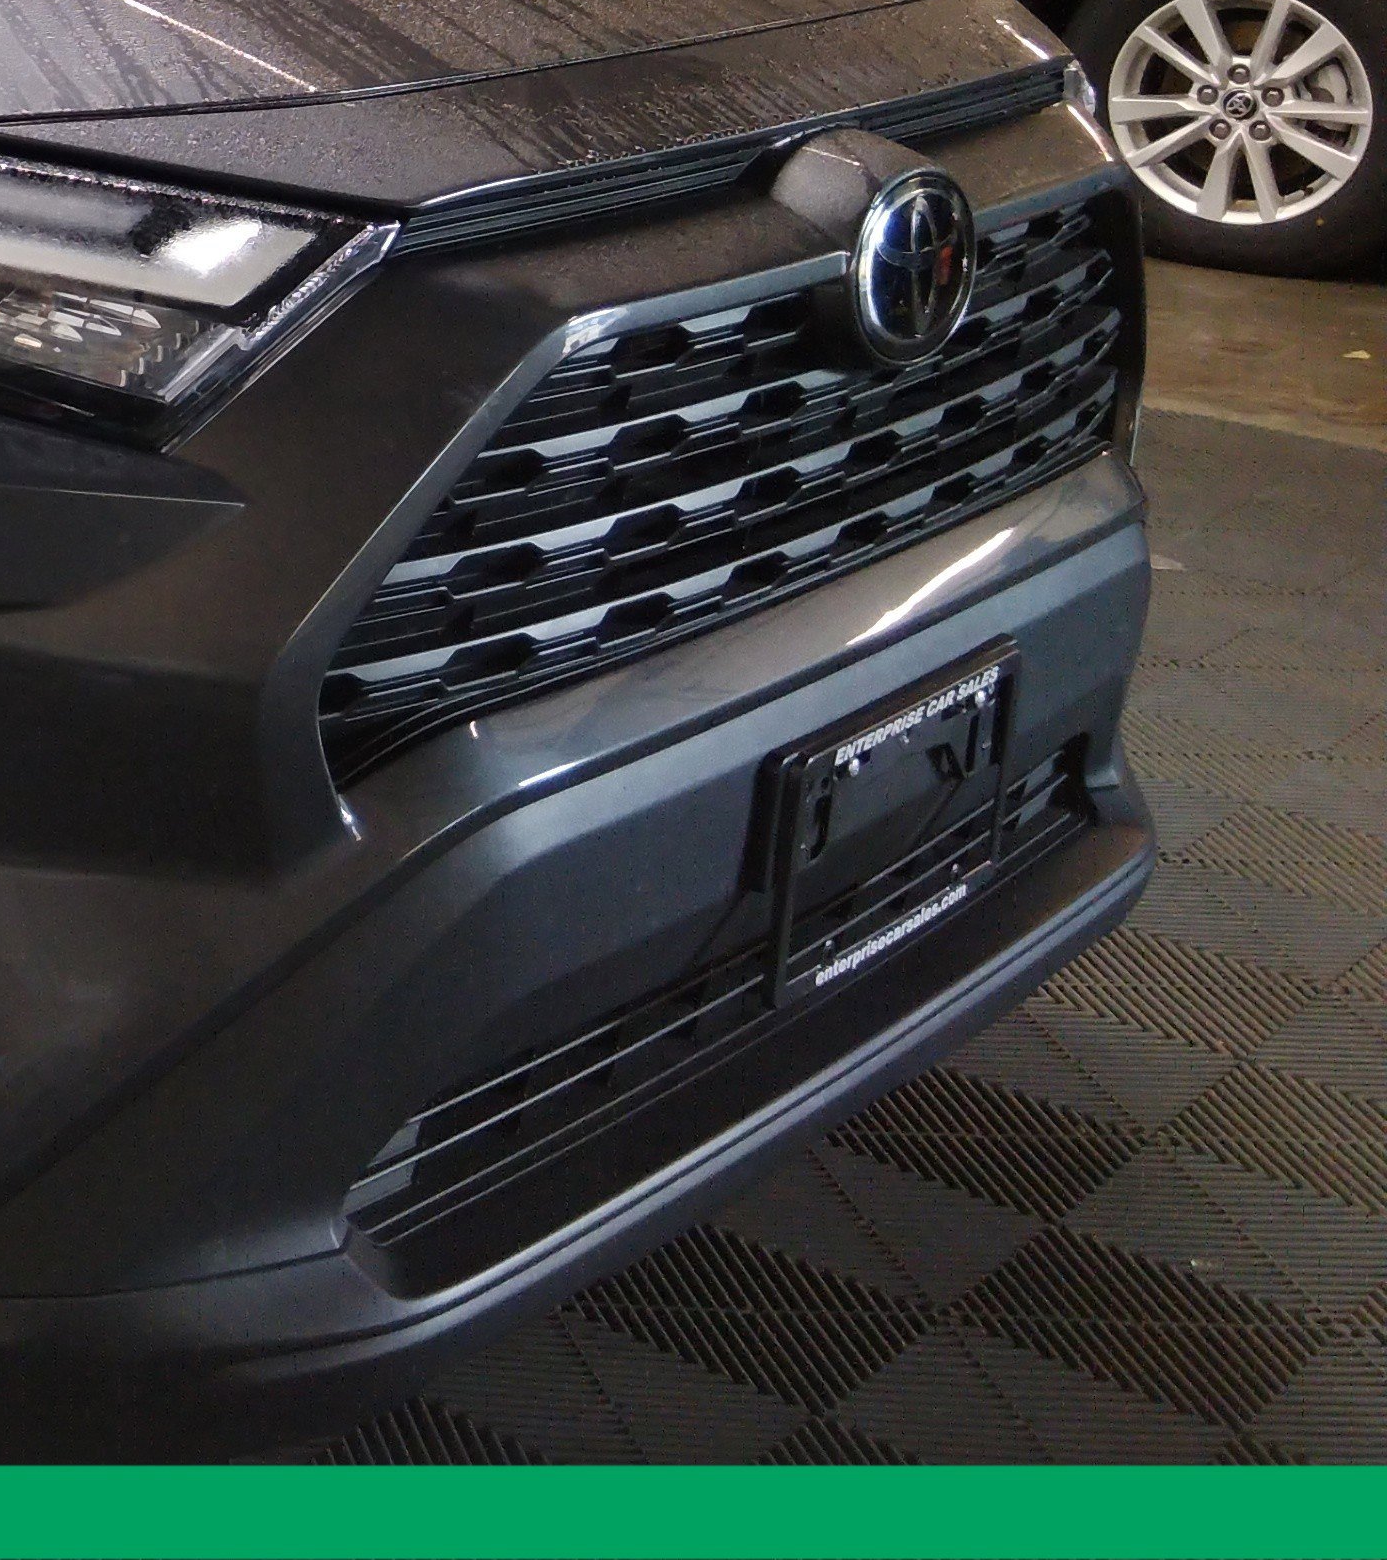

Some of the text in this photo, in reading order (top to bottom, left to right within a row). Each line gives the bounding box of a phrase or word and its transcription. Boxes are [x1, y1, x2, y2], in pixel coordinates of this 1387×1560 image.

[834, 665, 1000, 767] ENTERPRISE CAR SALES
[815, 884, 967, 987] enterprisecarsales.com
